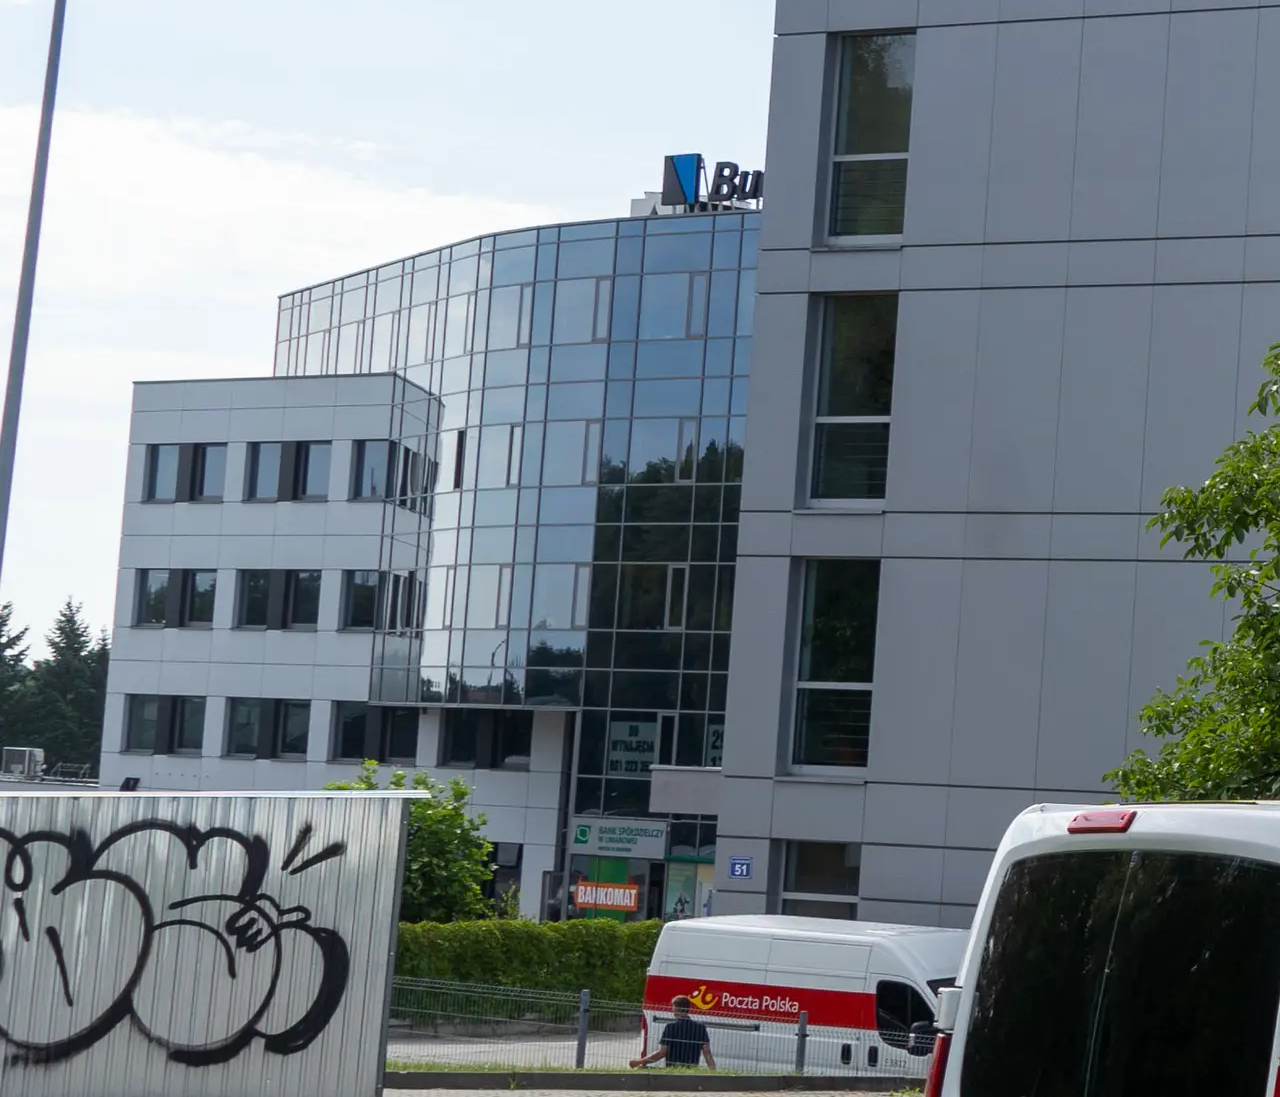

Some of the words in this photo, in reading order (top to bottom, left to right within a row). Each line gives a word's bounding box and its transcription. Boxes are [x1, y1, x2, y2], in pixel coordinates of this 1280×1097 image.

[708, 161, 764, 202] Bu
[599, 826, 617, 835] BANK
[735, 864, 747, 876] 51
[577, 885, 637, 907] BANKOMAT
[721, 992, 760, 1009] Poczta
[762, 995, 799, 1013] Polska
